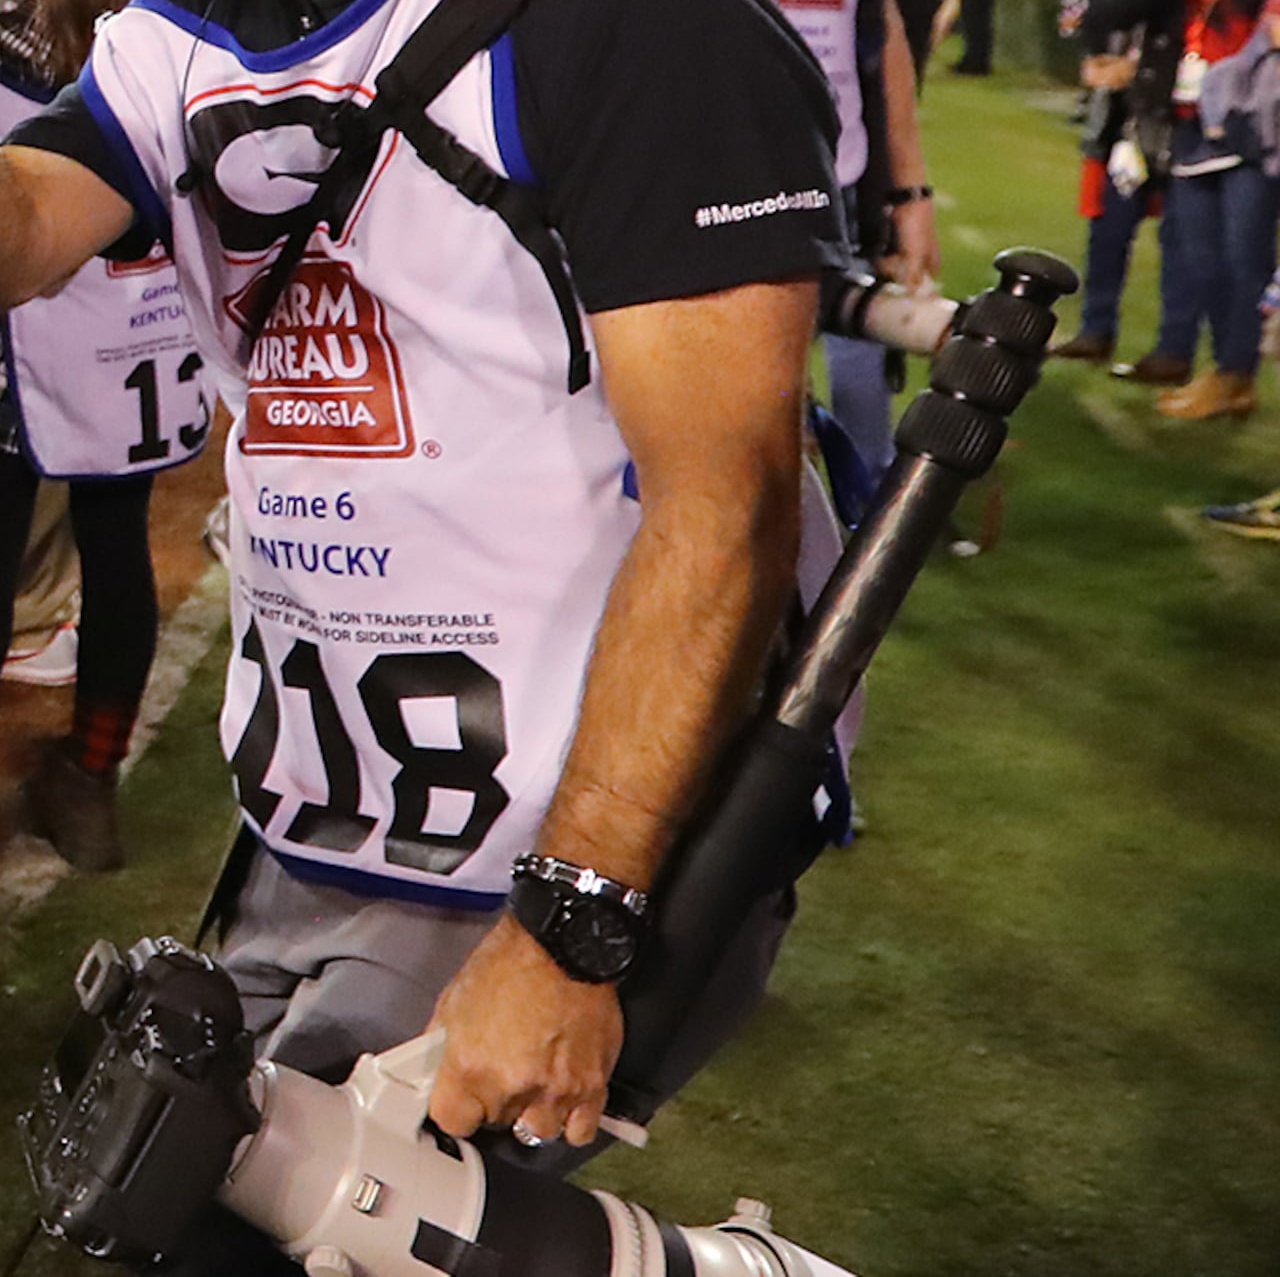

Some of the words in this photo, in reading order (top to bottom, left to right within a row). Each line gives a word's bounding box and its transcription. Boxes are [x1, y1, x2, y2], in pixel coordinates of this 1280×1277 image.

[266, 283, 359, 329] ARM
[248, 333, 370, 382] UREAU
[266, 398, 377, 428] GEORGIA
[258, 486, 328, 519] Game
[335, 491, 356, 521] 6
[251, 535, 392, 577] NTUCKY
[323, 628, 351, 643] FOR
[355, 631, 426, 645] SIDELINE
[431, 631, 500, 645] ACCESS
[329, 611, 361, 625] NON
[366, 613, 496, 626] TRANSFERABLE
[230, 614, 511, 876] 118
